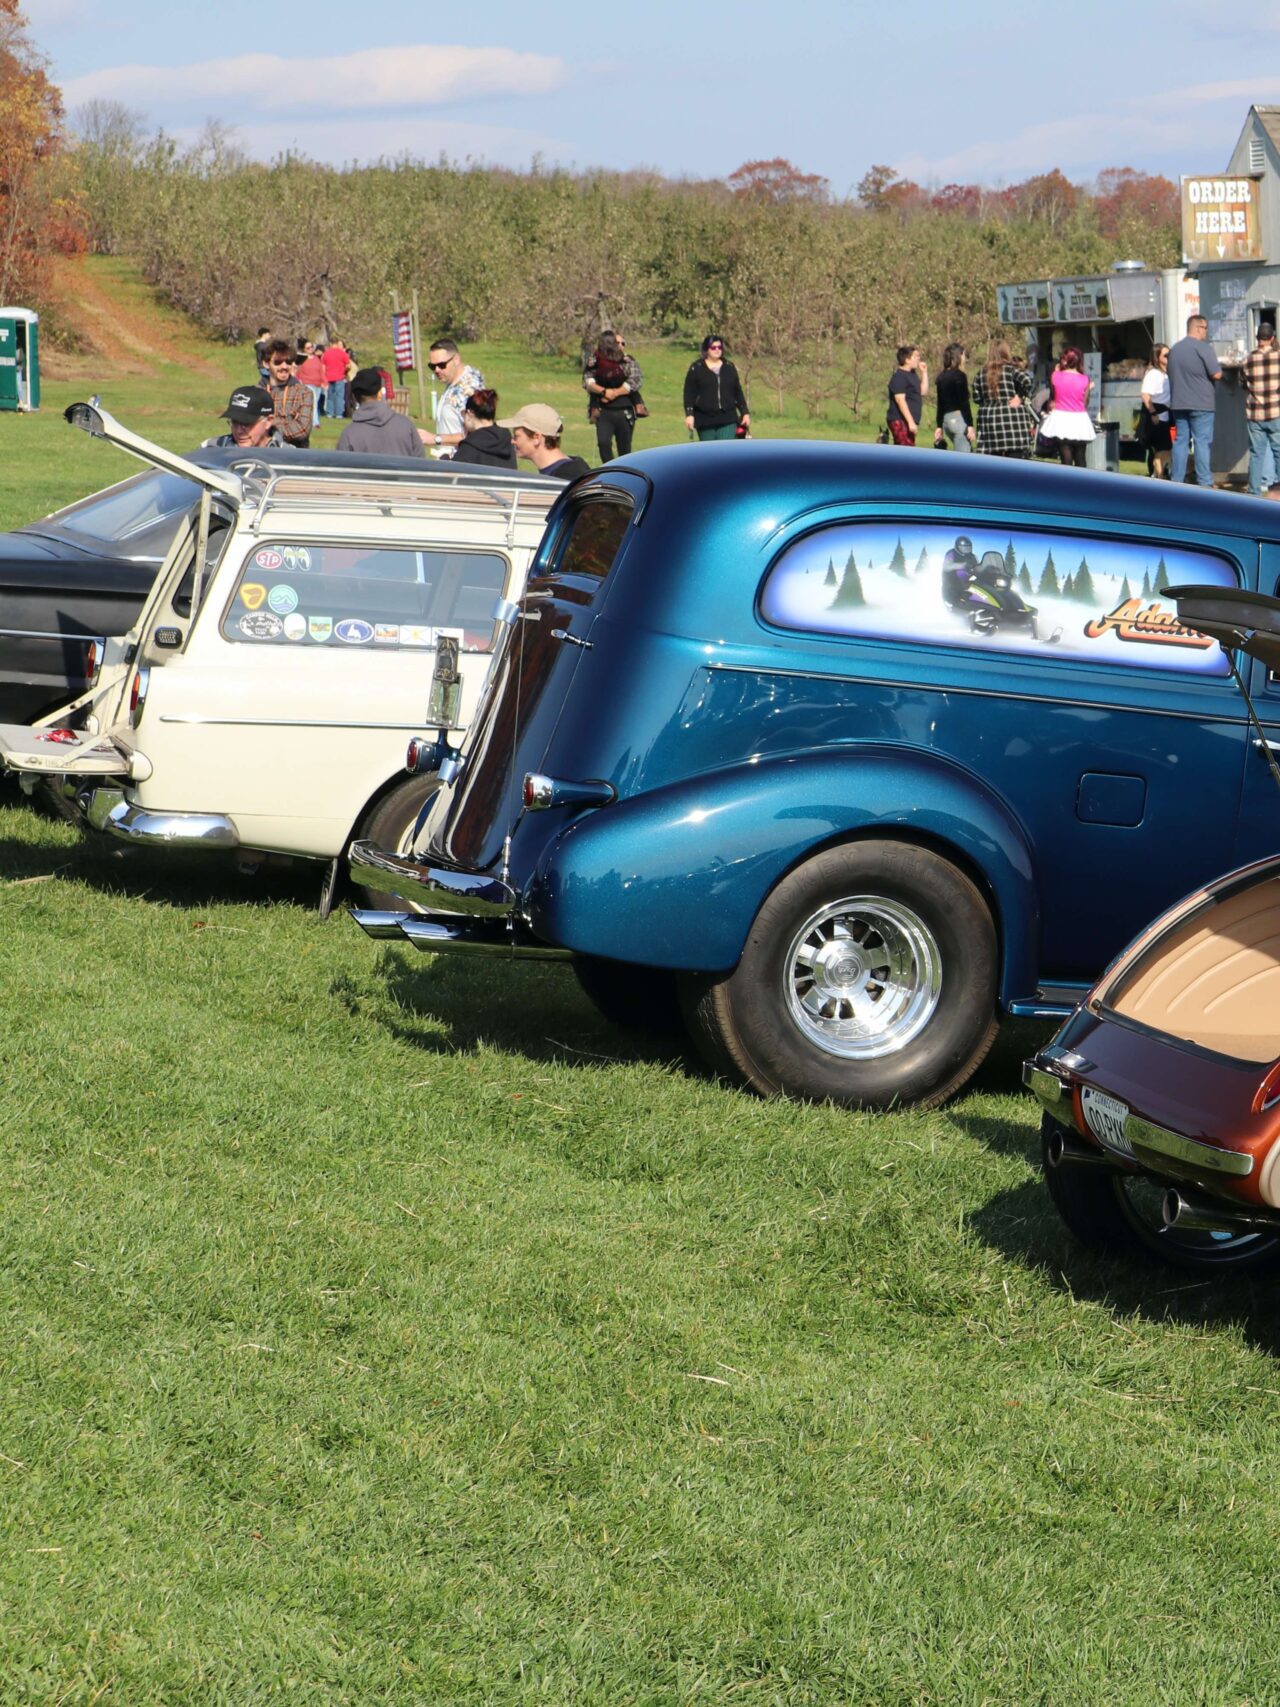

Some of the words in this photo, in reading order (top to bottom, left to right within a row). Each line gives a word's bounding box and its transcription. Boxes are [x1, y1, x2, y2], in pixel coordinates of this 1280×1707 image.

[1188, 181, 1251, 203] ORDER
[1195, 210, 1246, 233] HERE
[259, 552, 280, 566] STP
